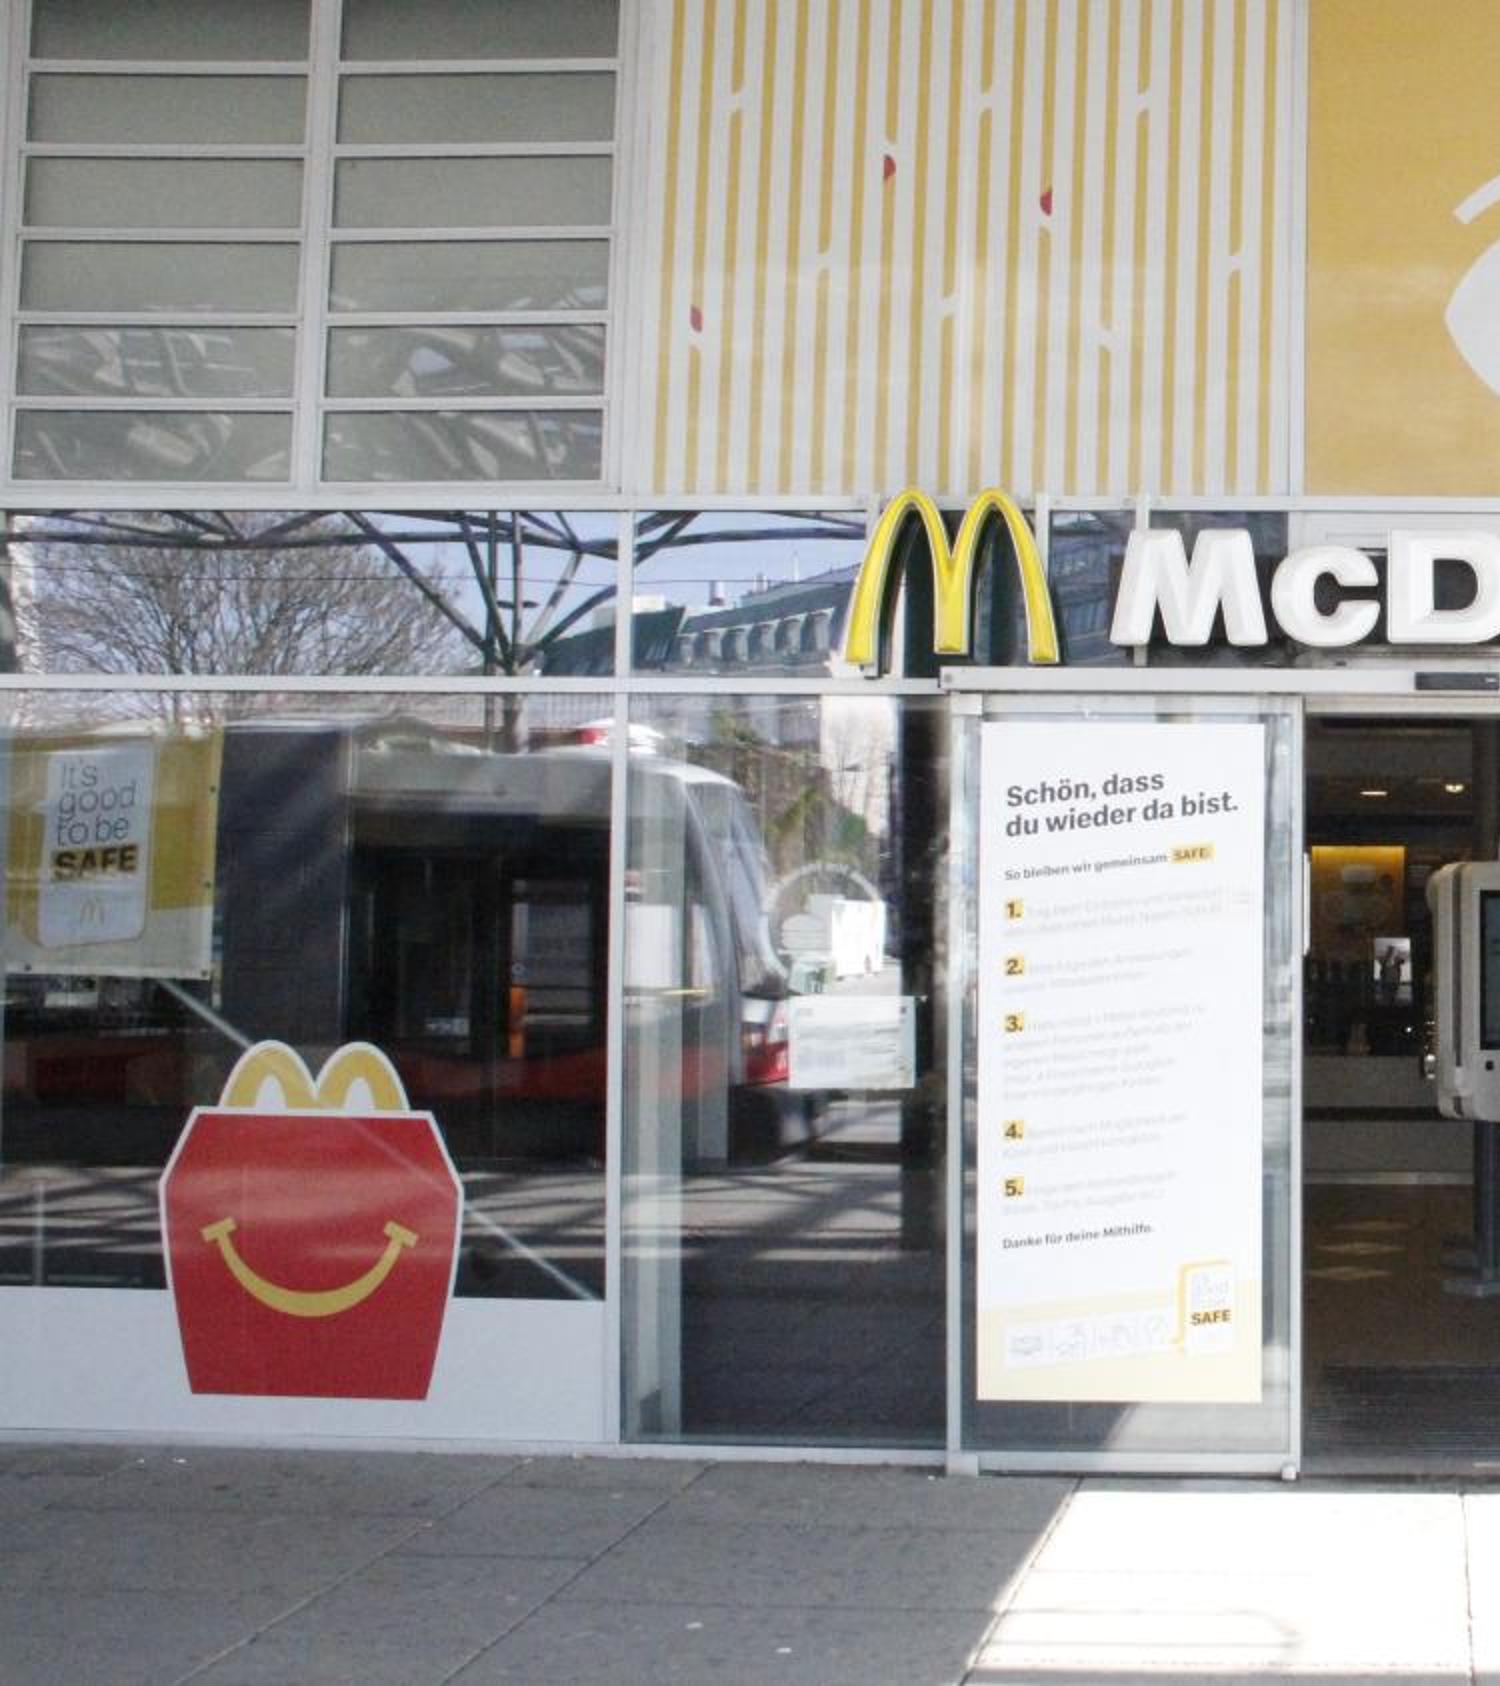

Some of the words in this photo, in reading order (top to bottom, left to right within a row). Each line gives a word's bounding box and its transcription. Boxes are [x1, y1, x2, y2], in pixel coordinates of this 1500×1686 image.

[58, 781, 136, 822] good
[1006, 778, 1097, 807] Schön,
[1102, 773, 1165, 796] dass
[57, 814, 89, 847] to
[95, 815, 129, 843] be
[1005, 814, 1039, 837] du
[1045, 804, 1137, 833] wieder
[1142, 799, 1174, 822] da
[1181, 791, 1239, 817] bist.
[54, 845, 138, 878] SAFE
[1003, 869, 1021, 881] So
[1023, 864, 1070, 879] bleiben
[1072, 861, 1092, 874] wir
[1093, 852, 1168, 873] gemeinsam
[1191, 1309, 1231, 1326] SAFE
